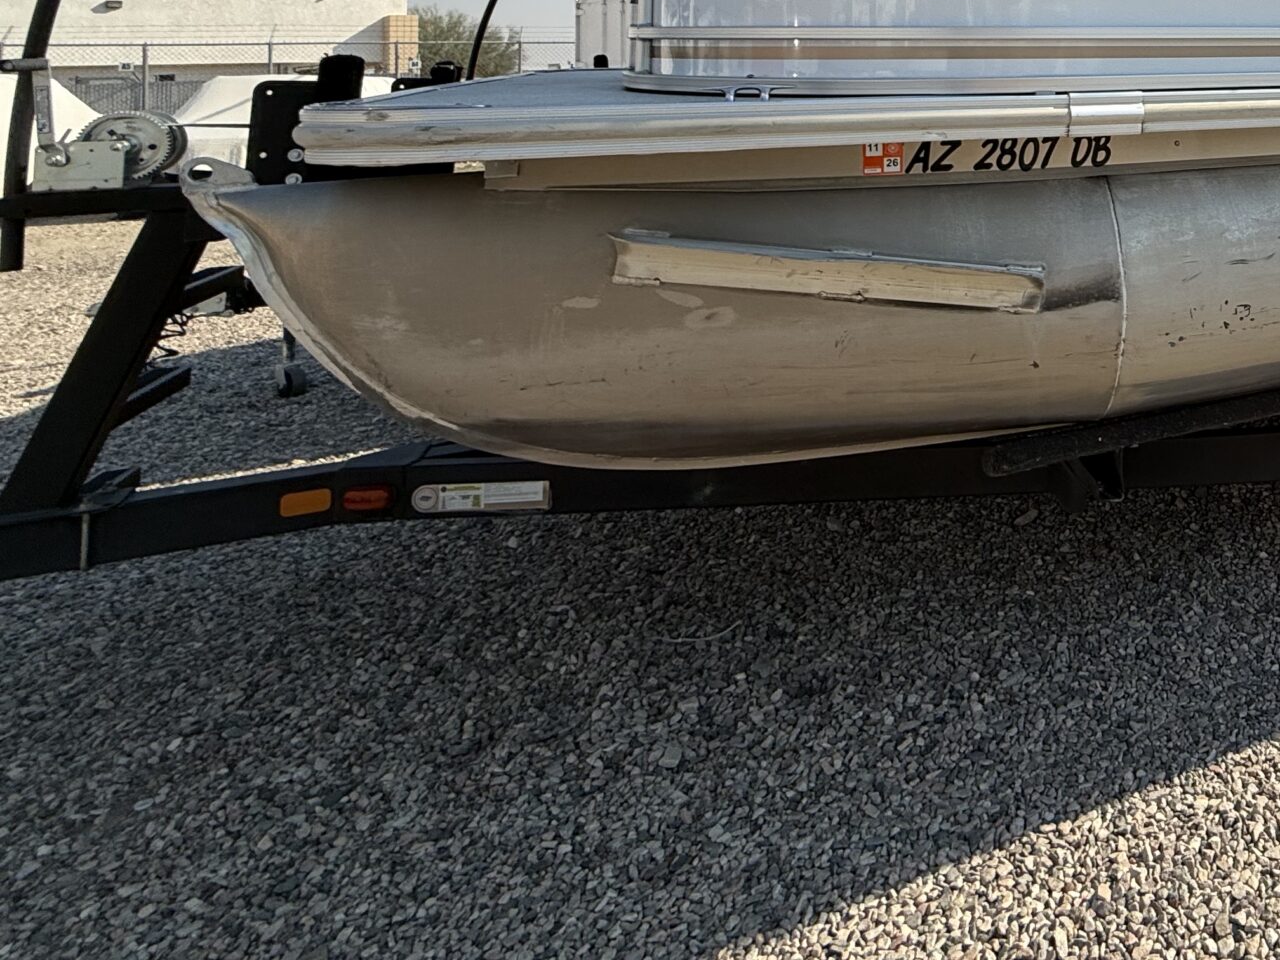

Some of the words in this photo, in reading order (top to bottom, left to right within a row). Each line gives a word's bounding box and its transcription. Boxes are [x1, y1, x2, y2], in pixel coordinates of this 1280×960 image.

[867, 143, 879, 152] 11
[904, 140, 962, 174] AZ
[973, 136, 1060, 172] 2807
[886, 158, 899, 167] 26
